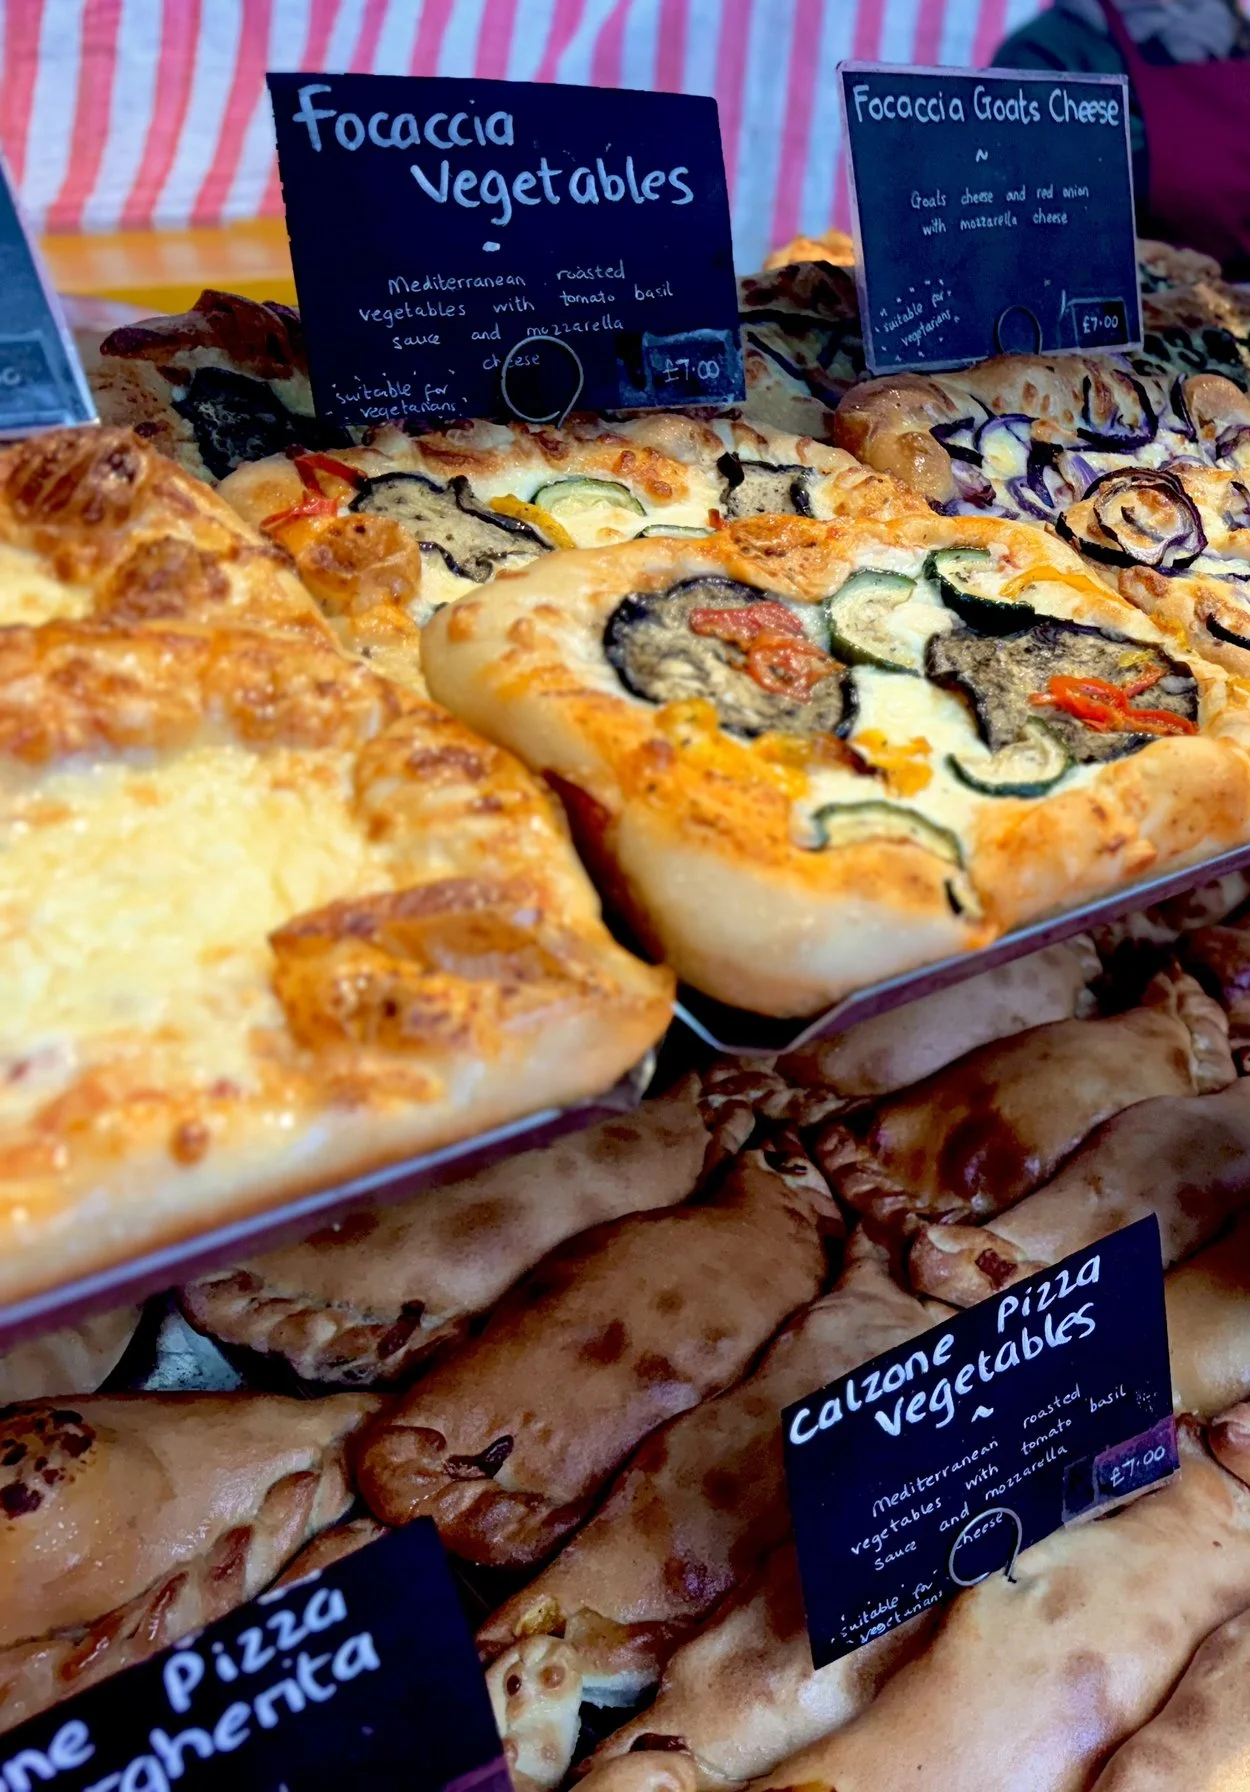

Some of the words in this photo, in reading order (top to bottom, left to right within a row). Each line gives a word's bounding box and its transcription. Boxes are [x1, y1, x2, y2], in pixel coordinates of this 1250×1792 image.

[294, 84, 514, 151] Focaccia
[852, 84, 965, 123] Focaccia
[973, 85, 1041, 125] Goats
[1049, 88, 1120, 126] Cheese
[411, 155, 694, 225] Vegetables
[911, 189, 946, 209] Goats
[961, 187, 993, 205] cheese
[1006, 185, 1026, 201] and
[1036, 184, 1053, 200] red
[1063, 185, 1089, 198] onion
[923, 216, 946, 236] with
[960, 211, 1017, 230] mozzarella
[1033, 208, 1068, 225] cheese
[388, 275, 525, 295] Mediterranean
[557, 260, 625, 281] roasted
[359, 303, 466, 328] vegetables
[493, 297, 535, 313] with
[560, 291, 615, 306] tomato
[635, 283, 673, 300] basil
[883, 303, 923, 332] suitable
[932, 291, 944, 308] for
[1082, 315, 1118, 334] £7.00
[393, 332, 440, 349] sauce
[471, 325, 501, 341] and
[527, 315, 624, 337] mozzarella
[901, 309, 951, 346] vegetarians
[663, 357, 720, 383] £7.00
[336, 380, 411, 404] suitable
[425, 384, 448, 401] for
[360, 400, 456, 420] vegetarians
[789, 1333, 954, 1445] Calzone
[875, 1302, 1096, 1436] Vegetables
[851, 1496, 942, 1555] vegetables
[965, 1465, 999, 1491] with
[1021, 1418, 1072, 1456] tomato
[1090, 1384, 1126, 1413] basil
[872, 1439, 999, 1517] Mediterranean
[1023, 1384, 1081, 1429] roasted
[1109, 1446, 1166, 1487] £7.00
[874, 1541, 917, 1571] sauce
[939, 1501, 970, 1532] and
[985, 1445, 1068, 1500] mozzarella
[840, 1596, 898, 1638] suitable
[912, 1582, 933, 1600] for
[0, 1719, 95, 1792] ne
[162, 1588, 348, 1713] Pizza
[84, 1631, 381, 1792] gherita
